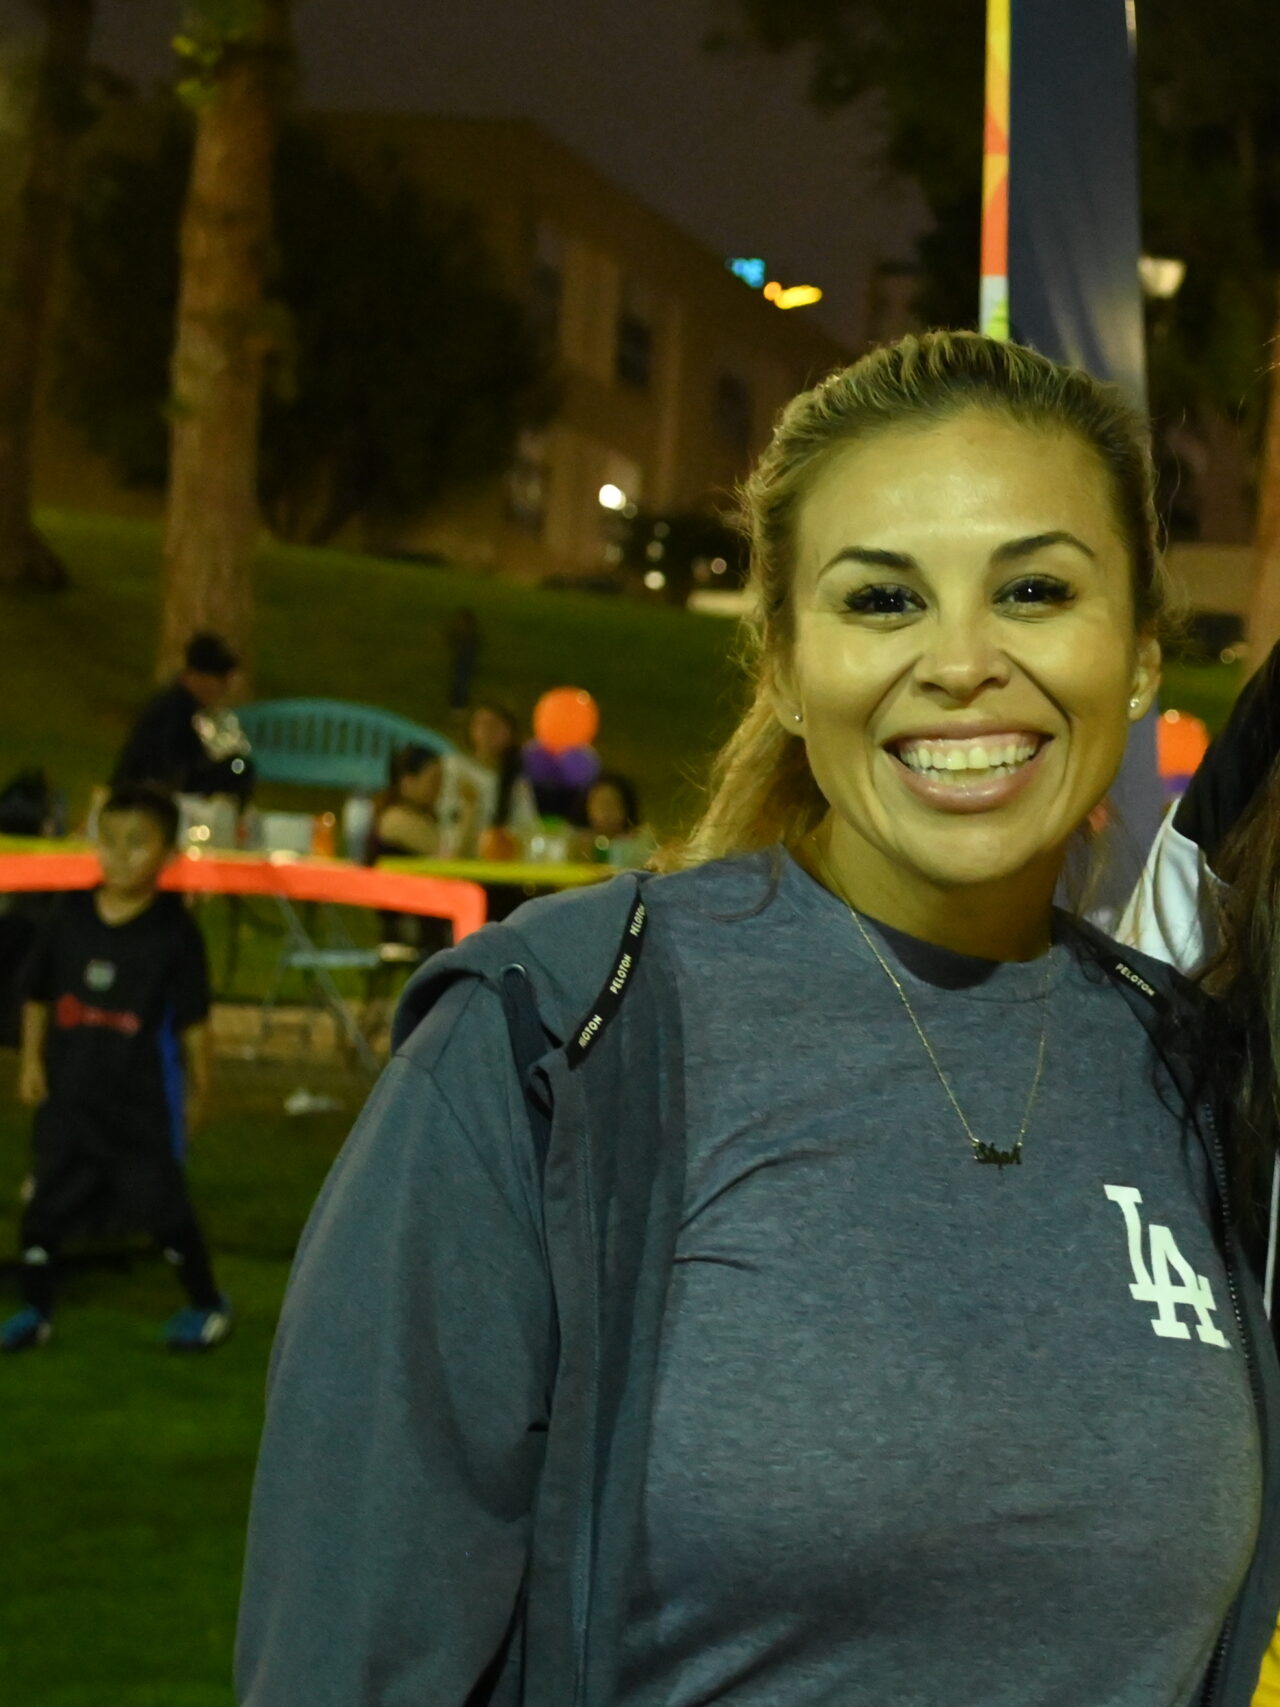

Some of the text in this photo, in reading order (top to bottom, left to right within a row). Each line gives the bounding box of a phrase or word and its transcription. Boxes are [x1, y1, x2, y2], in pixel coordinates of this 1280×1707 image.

[609, 953, 632, 995] PELOTON
[1114, 962, 1156, 997] PELOTON
[1103, 1184, 1232, 1349] LA
